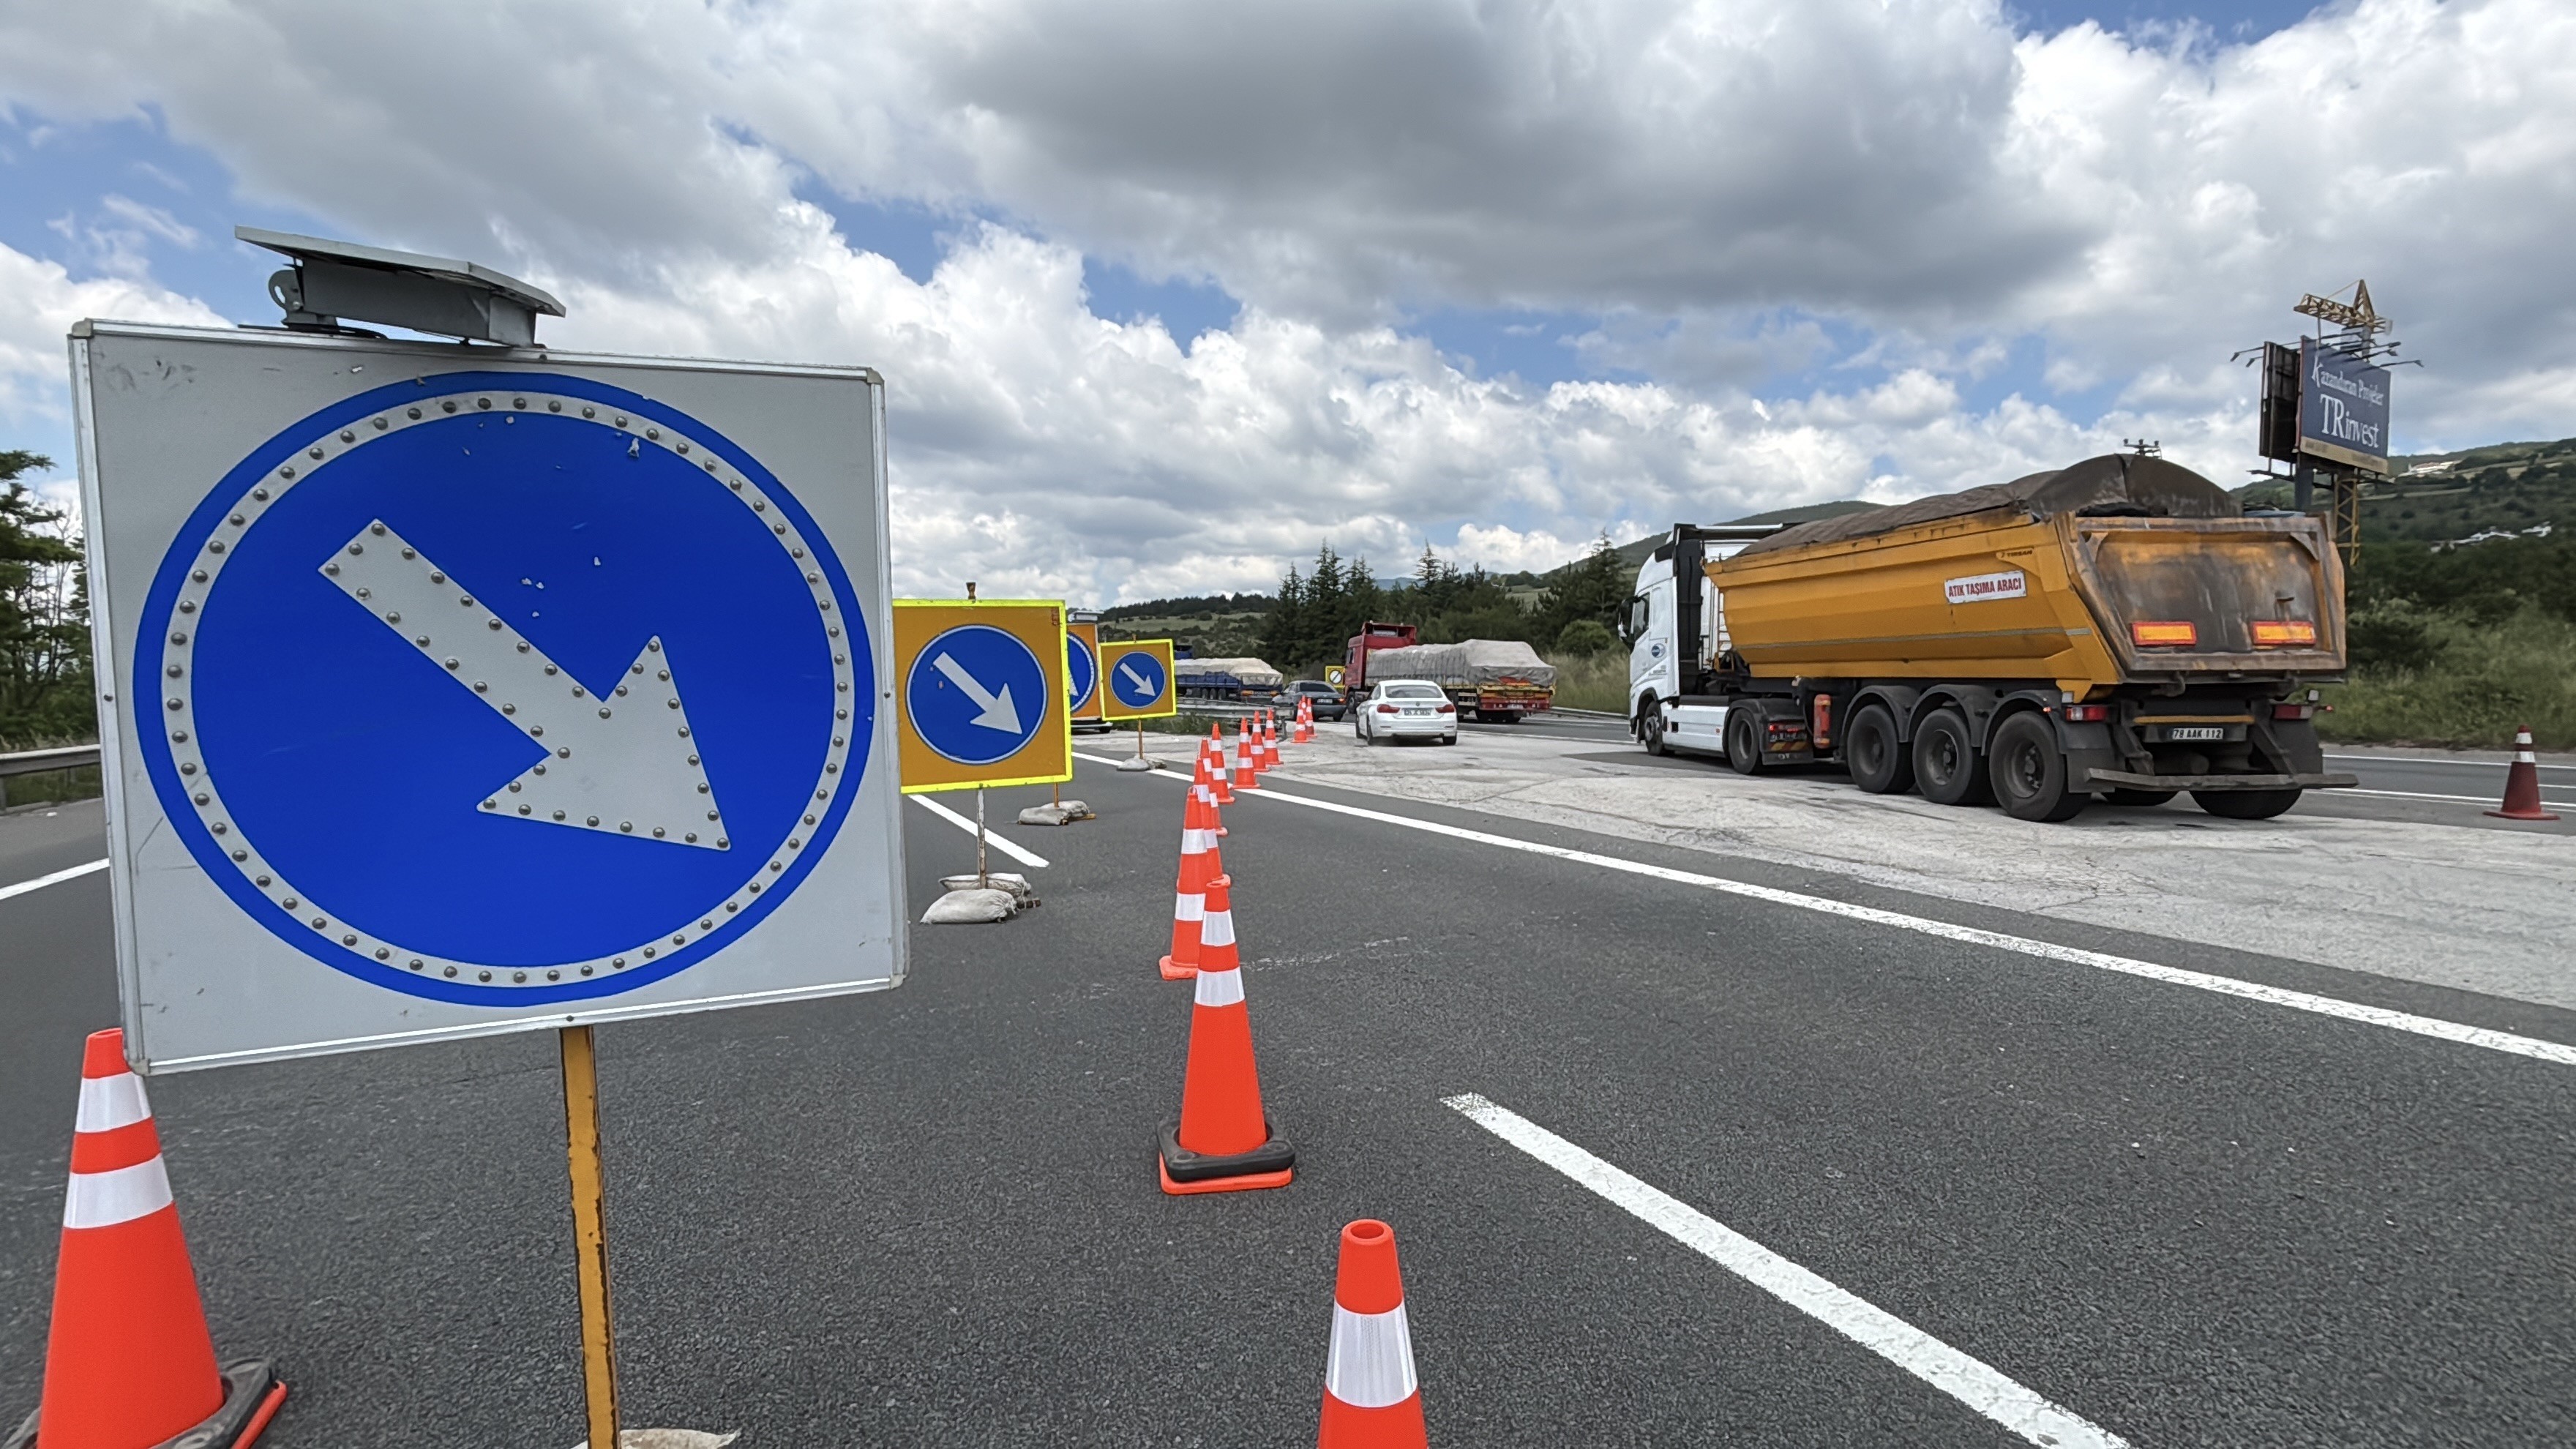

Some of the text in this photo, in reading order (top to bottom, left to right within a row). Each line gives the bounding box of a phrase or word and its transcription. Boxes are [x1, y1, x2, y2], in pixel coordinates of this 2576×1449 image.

[2319, 393, 2380, 449] TRinvest
[1948, 577, 2022, 597] ATIK TAŞIMA ARACI
